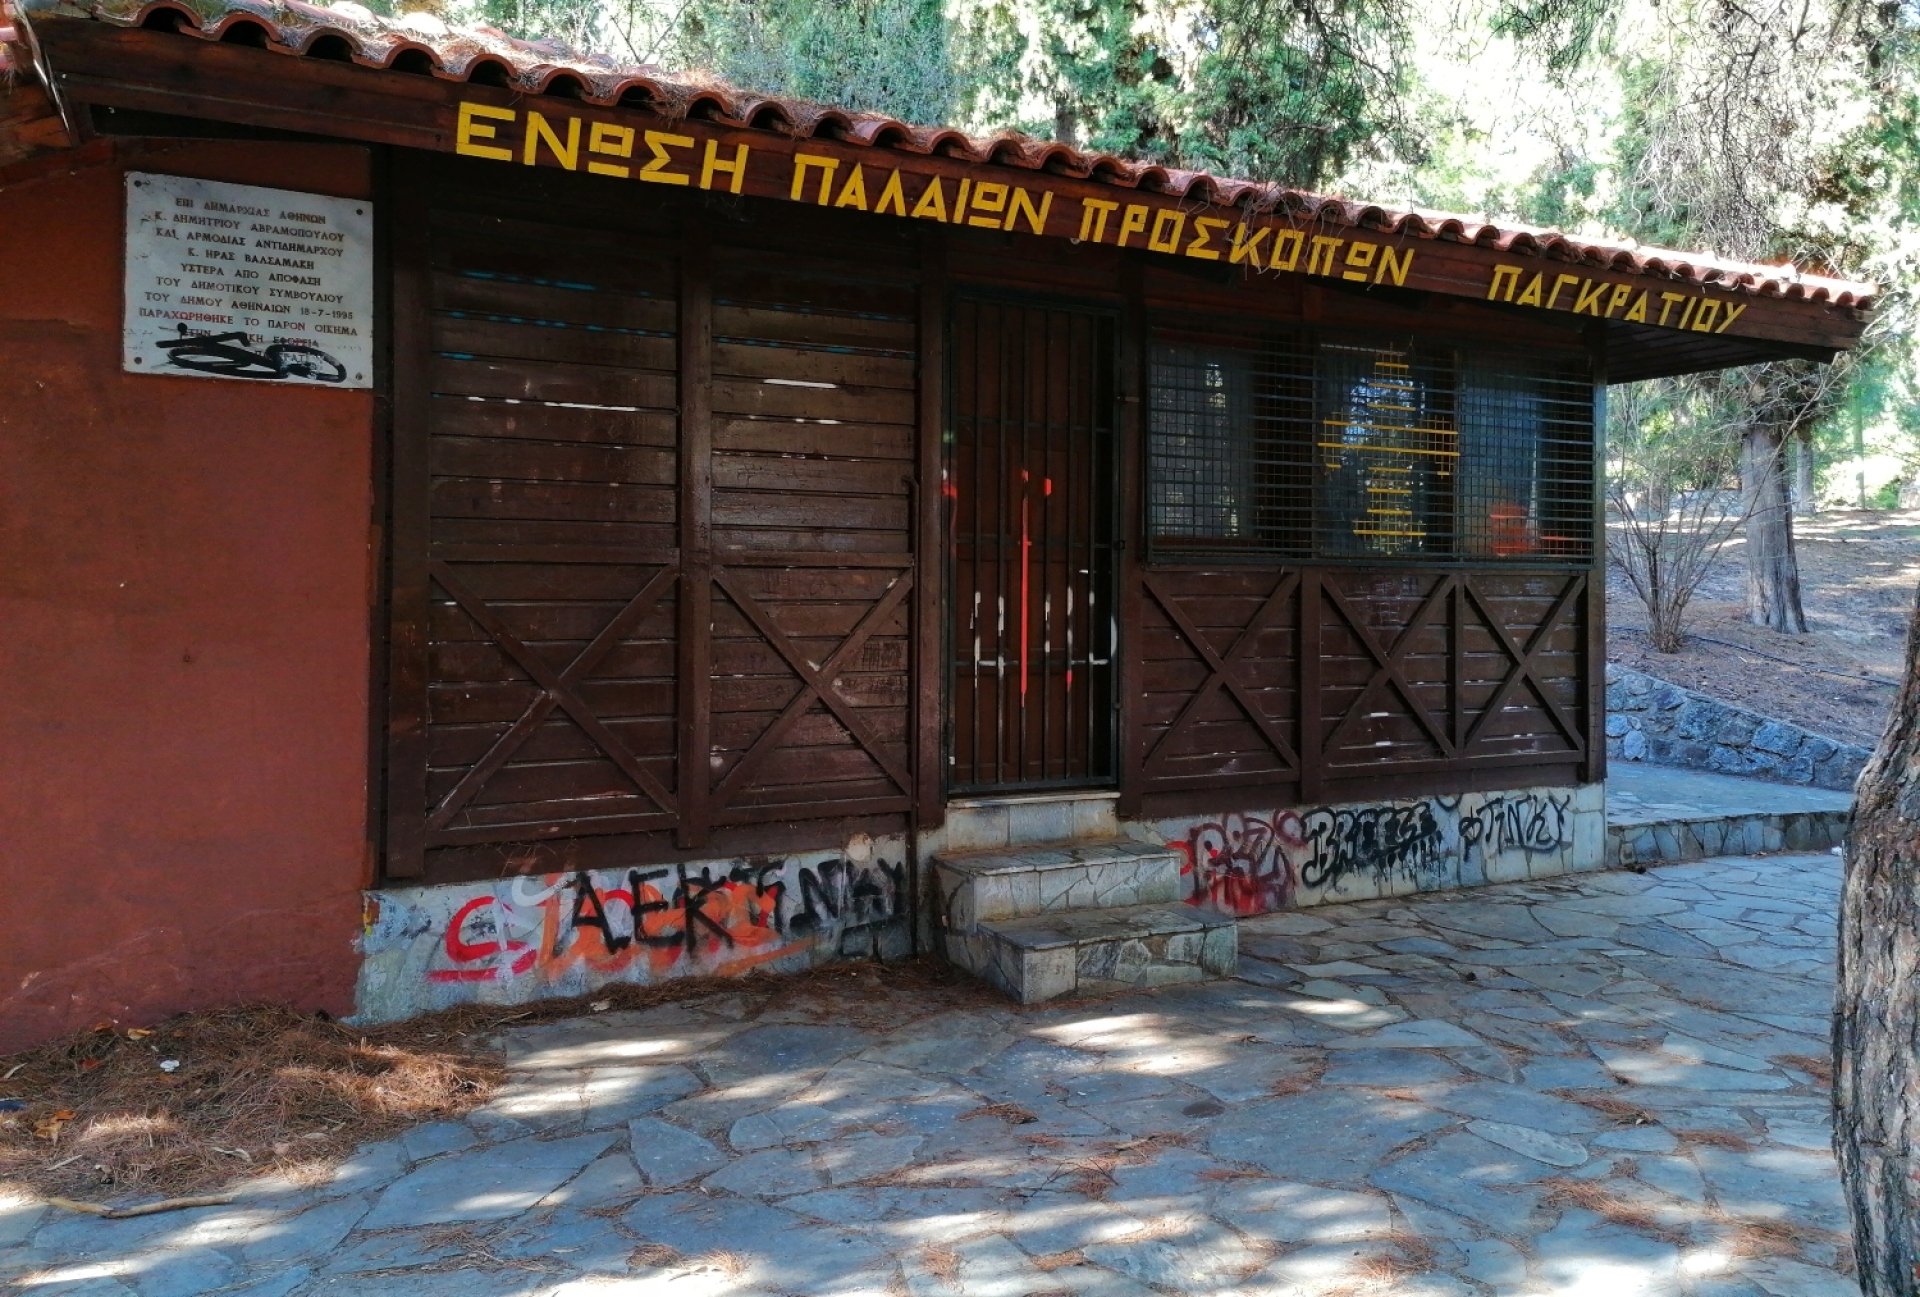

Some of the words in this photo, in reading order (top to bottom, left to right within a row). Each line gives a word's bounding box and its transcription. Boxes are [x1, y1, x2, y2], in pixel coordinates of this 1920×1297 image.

[175, 197, 194, 208] ΕΠΙ
[203, 201, 271, 217] ΔΗΜΑΡΧΙΑΣ
[279, 211, 326, 225] ΑΘΗΝΩΝ
[456, 101, 749, 194] ΕΝΩΣΗ
[791, 153, 1054, 236] ΠΑΛΑΙΩΝ
[1077, 197, 1415, 286] ΠΡΟΣΚΟΠΩΝ
[1488, 263, 1748, 334] ΠΑΓΚΡΑΤΙΟΥ
[155, 227, 178, 239] ΚΑΙ
[186, 231, 246, 246] ΑΡΜΟΔΙΑΣ
[255, 239, 344, 257] ΑΝΤΙΔΗΜΑΡΧΟΥ
[172, 214, 241, 229] ΔΗΜΗΤΡΙΟΥ
[250, 223, 345, 243] ΑΒΡΑΜΟΠΟΥΛΟΥ
[205, 249, 235, 261] ΗΡΑΣ
[244, 254, 315, 270] ΒΑΛΣΑΜΑΚΗ
[181, 263, 225, 276] ΥΣΤΕΡΑ
[234, 269, 259, 279] ΑΠΟ
[268, 272, 321, 286] ΑΠΟΦΑΣΗ
[145, 292, 170, 303] ΤΟΥ
[180, 296, 223, 308] ΔΗΜΟΥ
[231, 300, 291, 314] ΑΘΗΝΑΙΩΝ
[156, 276, 181, 288] ΤΟΥ
[191, 280, 260, 295] ΔΗΜΟΤΙΚΟΥ
[269, 287, 343, 304] ΣΥΜΒΟΥΛΙΟΥ
[139, 307, 234, 324] ΠΑΡΑΧΩΡΗΘΗΚΕ
[244, 317, 260, 327] ΤΟ
[267, 319, 306, 331] ΠΑΡΟΝ
[314, 324, 358, 337] ΟΙΚΗΜΑ
